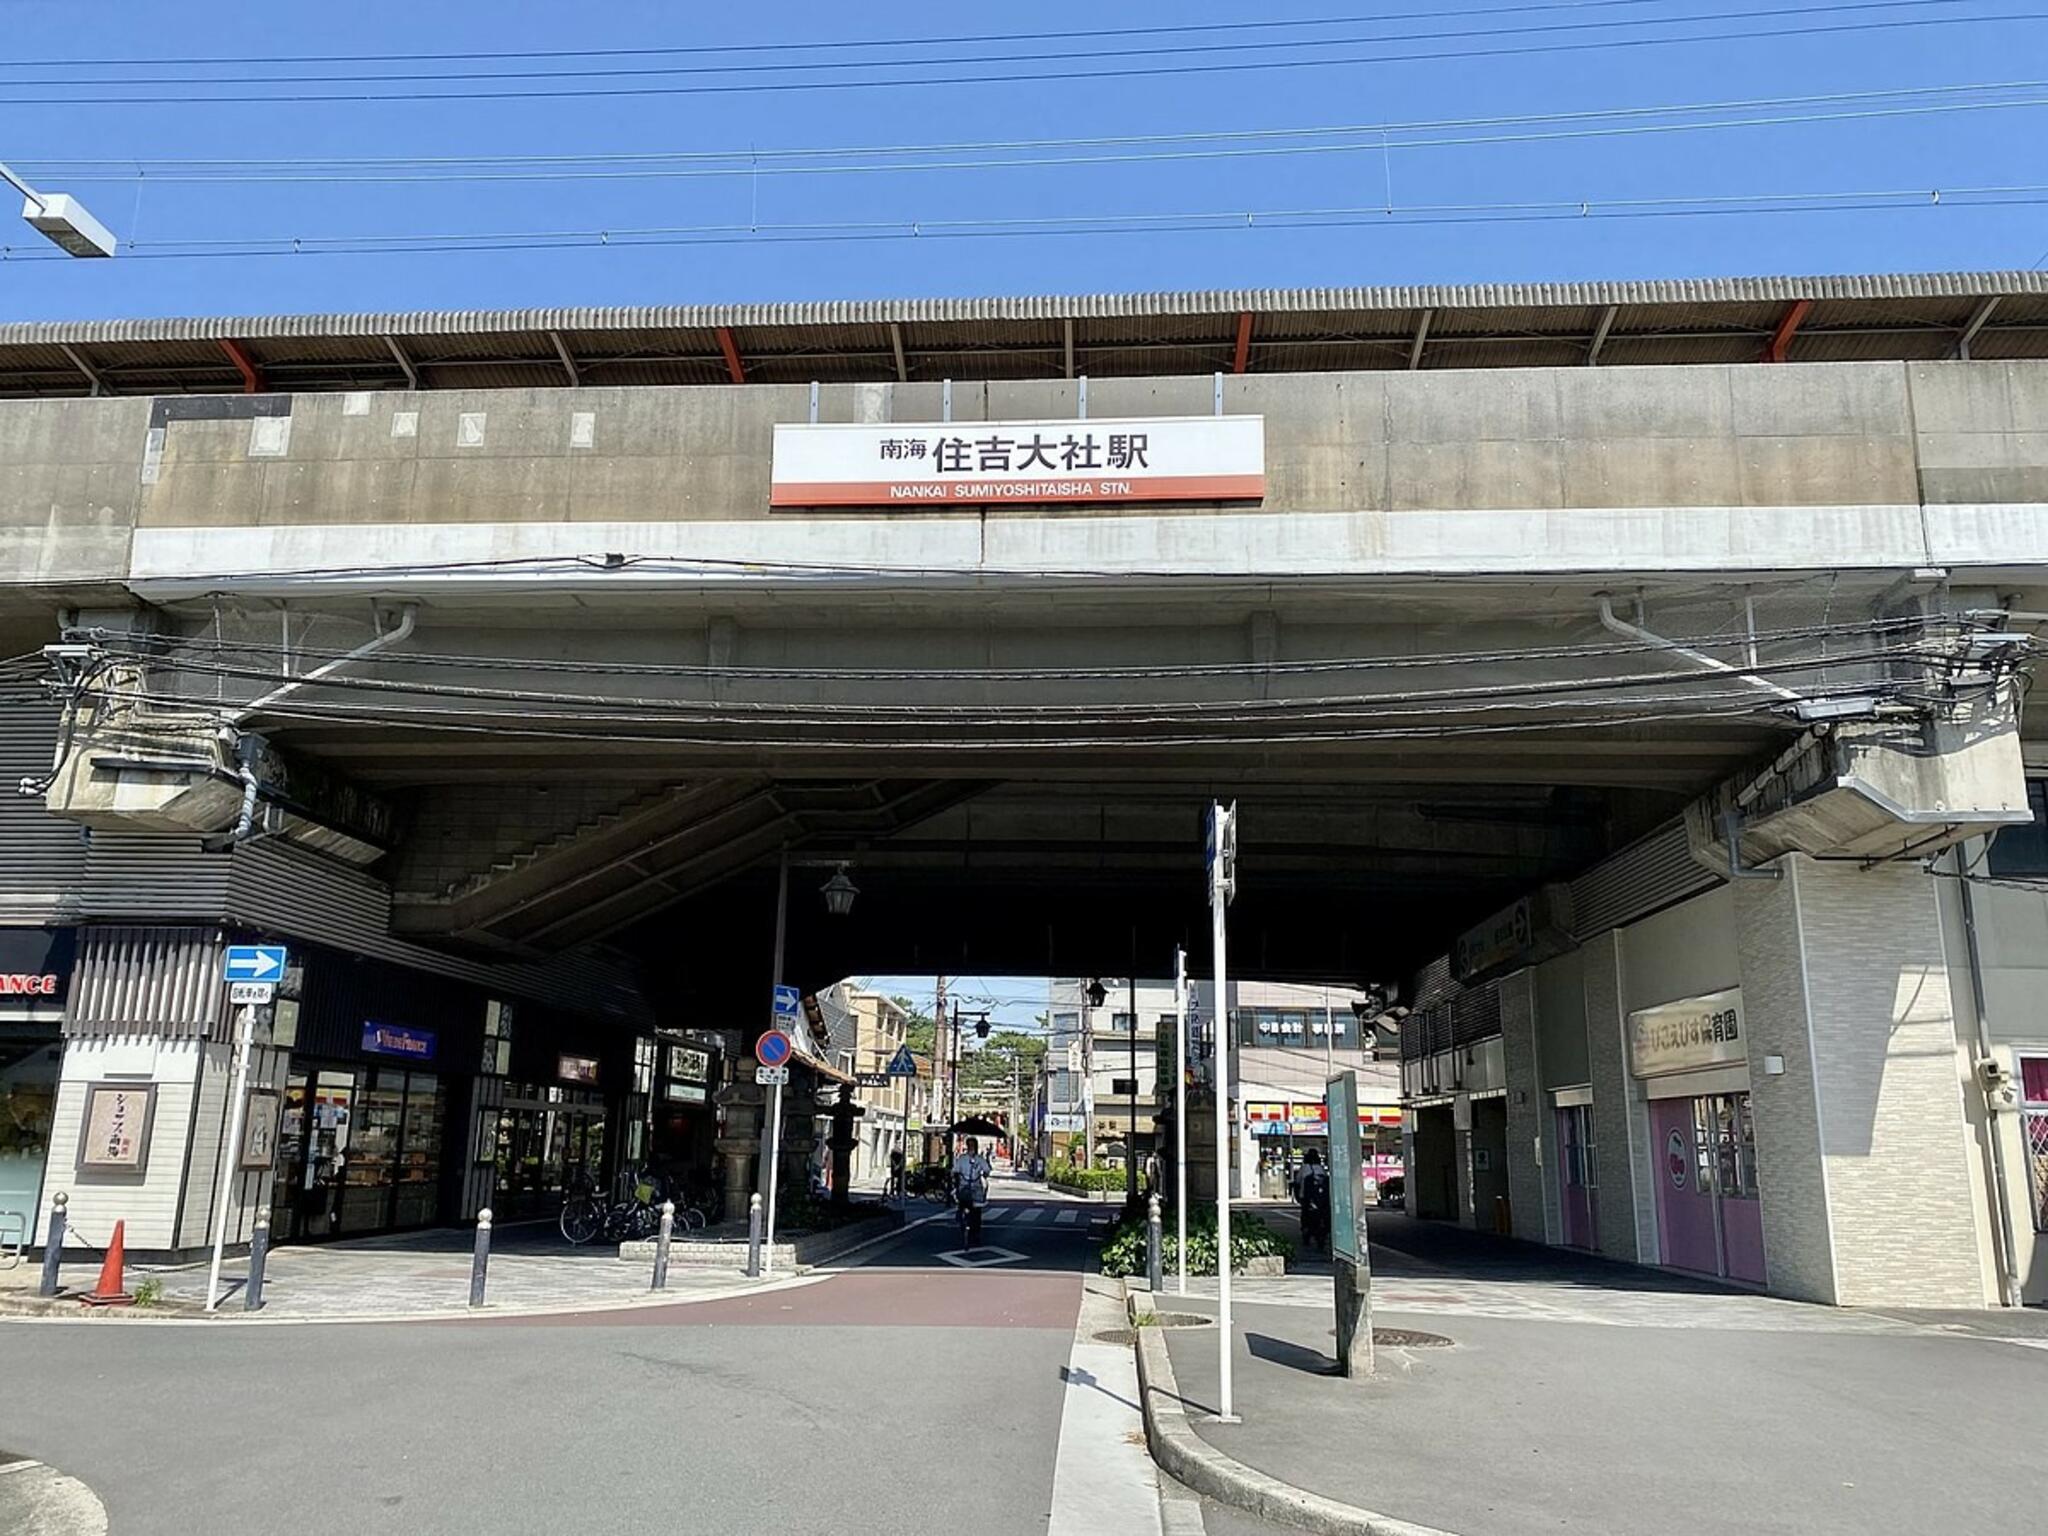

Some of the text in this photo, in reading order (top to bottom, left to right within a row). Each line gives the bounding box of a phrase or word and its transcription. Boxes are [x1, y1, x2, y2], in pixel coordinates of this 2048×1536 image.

[880, 434, 1150, 473] 南海 住吉大社駅
[890, 484, 947, 498] NANKAI
[954, 482, 1093, 497] SUMIYOSHITAISHA
